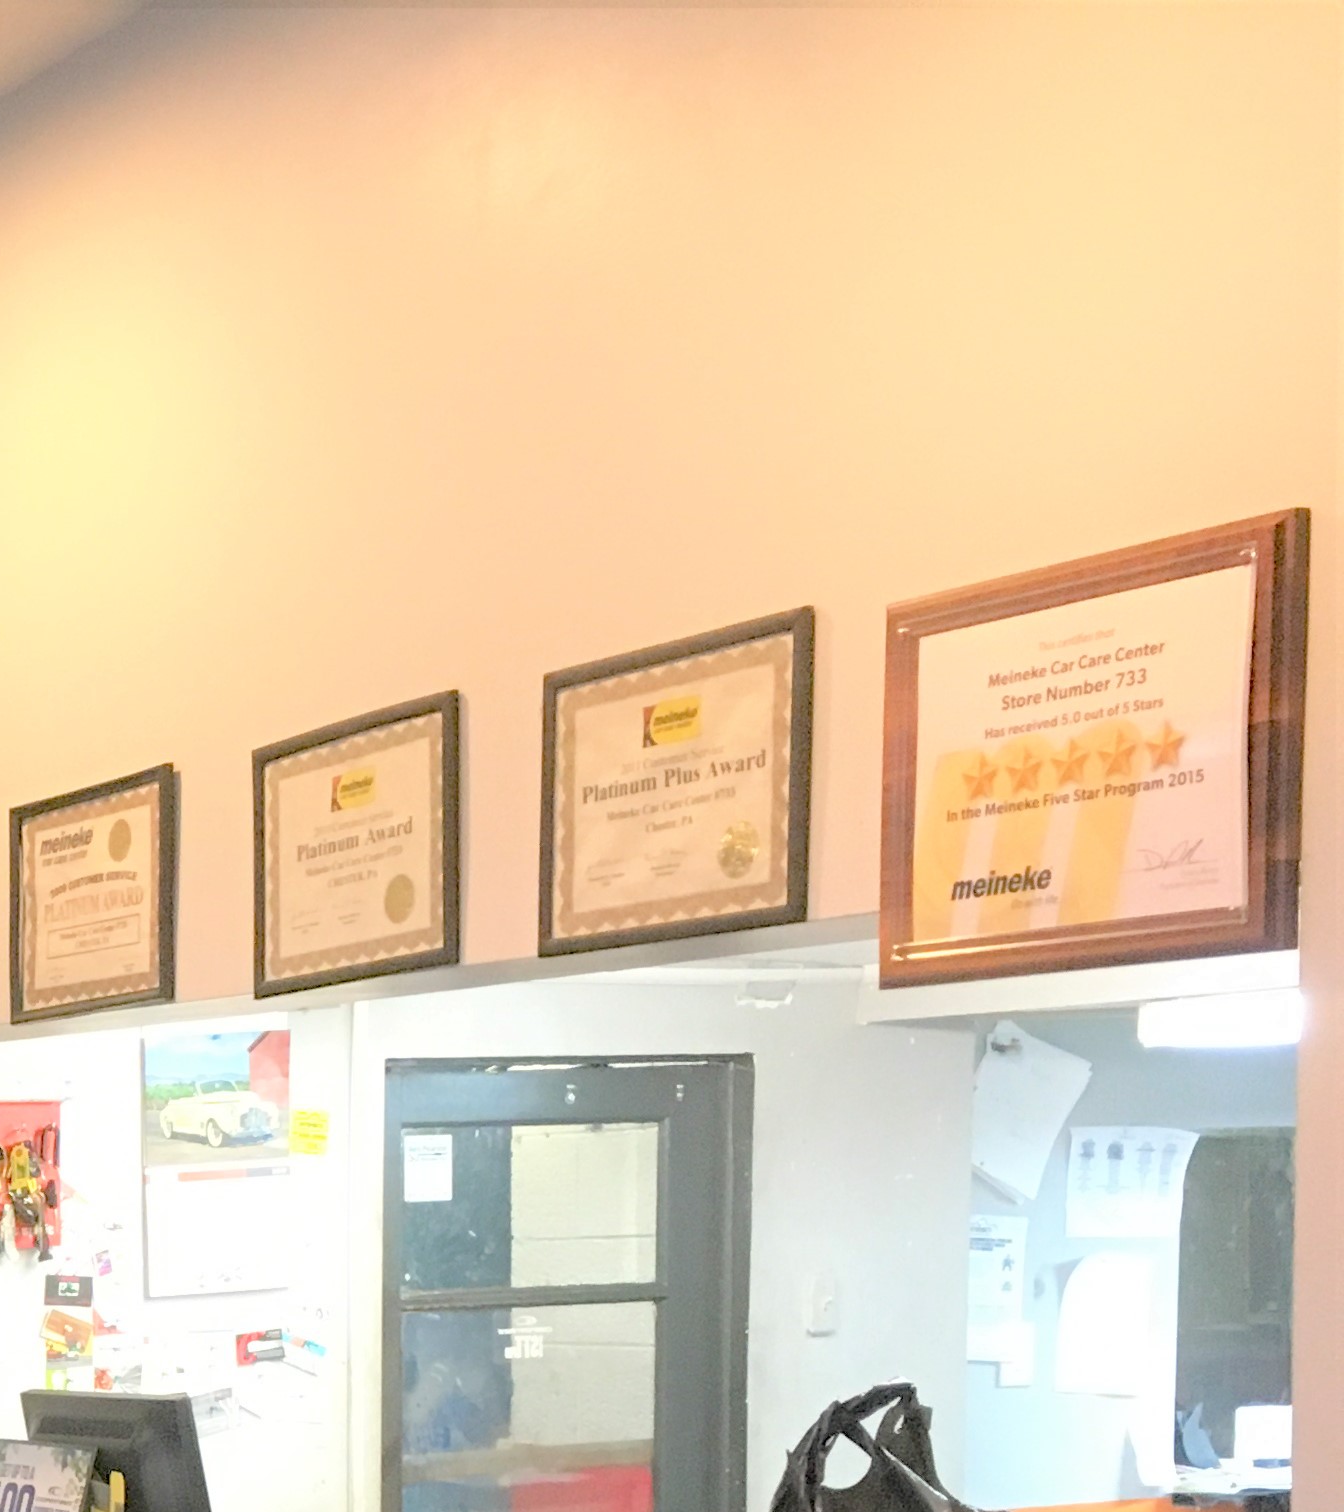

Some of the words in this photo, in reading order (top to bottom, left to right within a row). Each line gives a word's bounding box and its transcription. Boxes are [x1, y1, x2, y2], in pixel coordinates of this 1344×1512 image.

[987, 665, 1048, 688] Meineke
[1050, 660, 1075, 676] Car
[1078, 654, 1112, 670] Care
[1115, 640, 1166, 662] Center
[1001, 689, 1042, 711] Store
[1046, 677, 1111, 703] Number
[1116, 668, 1148, 689] 733
[984, 727, 1005, 740] Has
[1008, 715, 1058, 736] received
[1061, 711, 1082, 725] 5.0
[1084, 708, 1104, 722] out
[1107, 703, 1120, 717] of
[1122, 703, 1131, 714] 5
[1133, 697, 1164, 712] Stars
[582, 776, 657, 804] Platinum
[664, 766, 701, 788] Plus
[705, 748, 766, 779] Award
[946, 809, 958, 822] In
[961, 806, 982, 820] the
[984, 797, 1040, 817] Meineke
[1043, 792, 1070, 807] Five
[1073, 788, 1102, 802] Star
[1103, 776, 1164, 799] Program
[1168, 769, 1205, 788] 2015
[40, 826, 93, 856] meineke
[297, 835, 359, 863] Platinum
[364, 815, 413, 846] Award
[950, 864, 1052, 902] meineke
